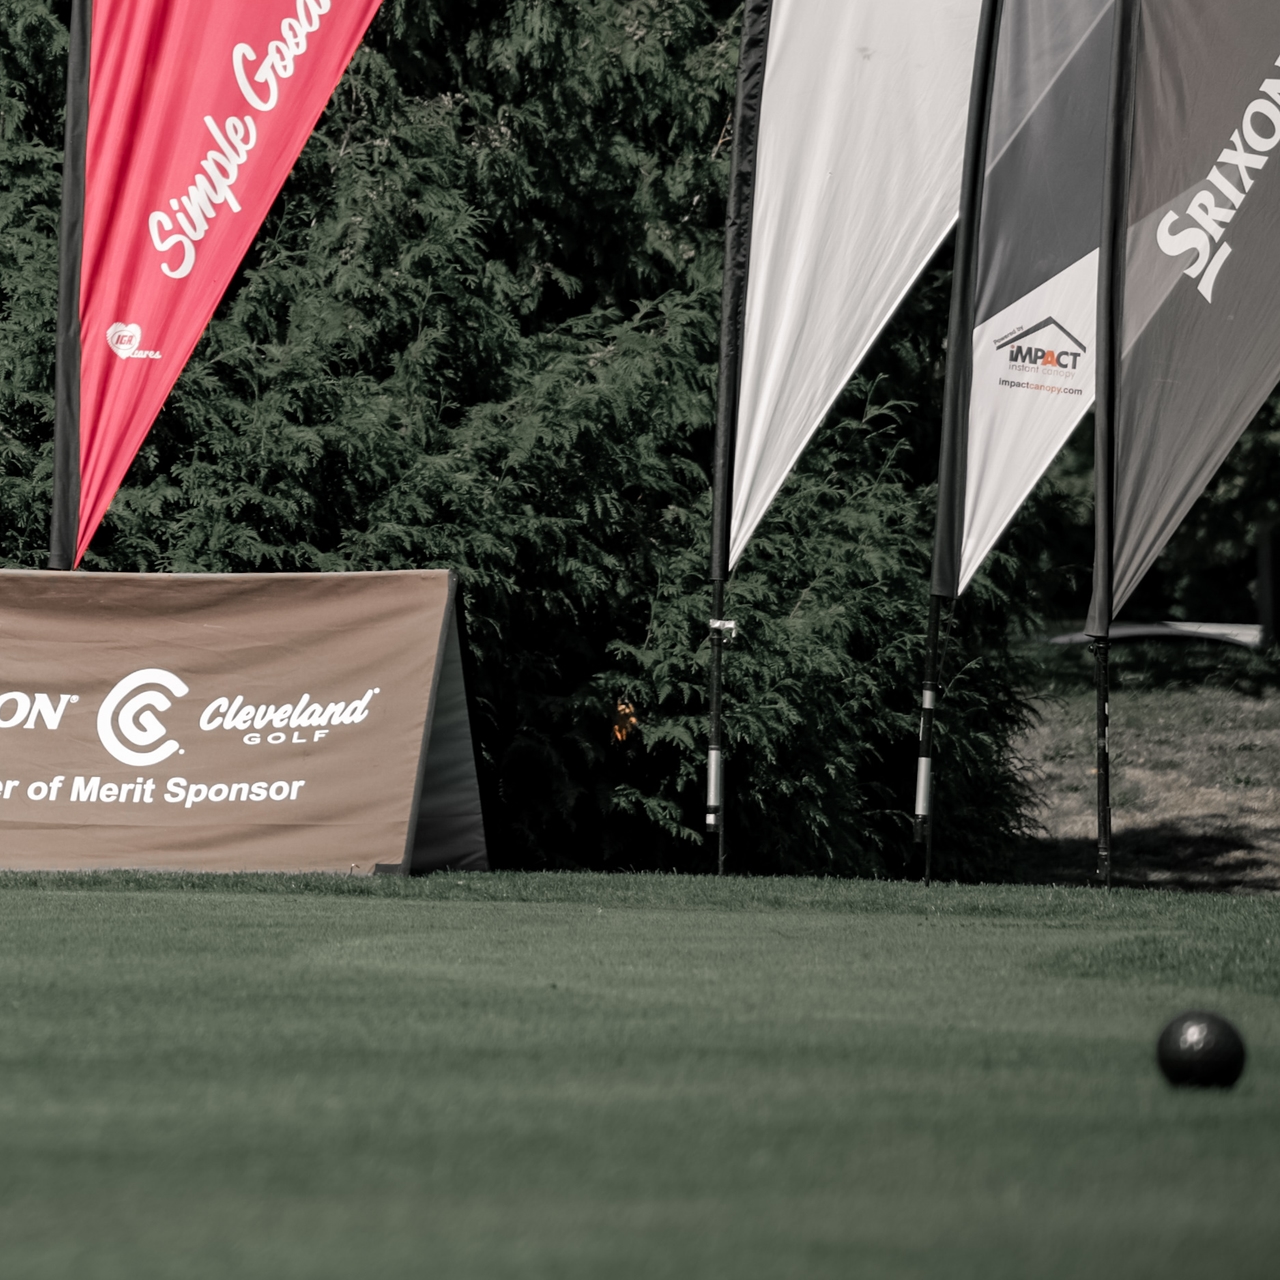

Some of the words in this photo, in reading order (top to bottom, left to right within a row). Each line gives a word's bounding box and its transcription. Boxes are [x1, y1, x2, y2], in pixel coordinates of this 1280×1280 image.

[148, 115, 257, 279] Simple
[114, 334, 134, 346] IGA
[993, 328, 1017, 345] Powered
[1016, 325, 1024, 333] by
[1008, 362, 1040, 374] instant
[1042, 367, 1076, 380] canopy
[998, 377, 1083, 396] impactcanopy.com
[198, 688, 376, 731] Cleveland
[242, 729, 329, 745] GOLF
[26, 776, 65, 801] of
[69, 776, 156, 804] Merit
[162, 777, 305, 808] Sponsor
